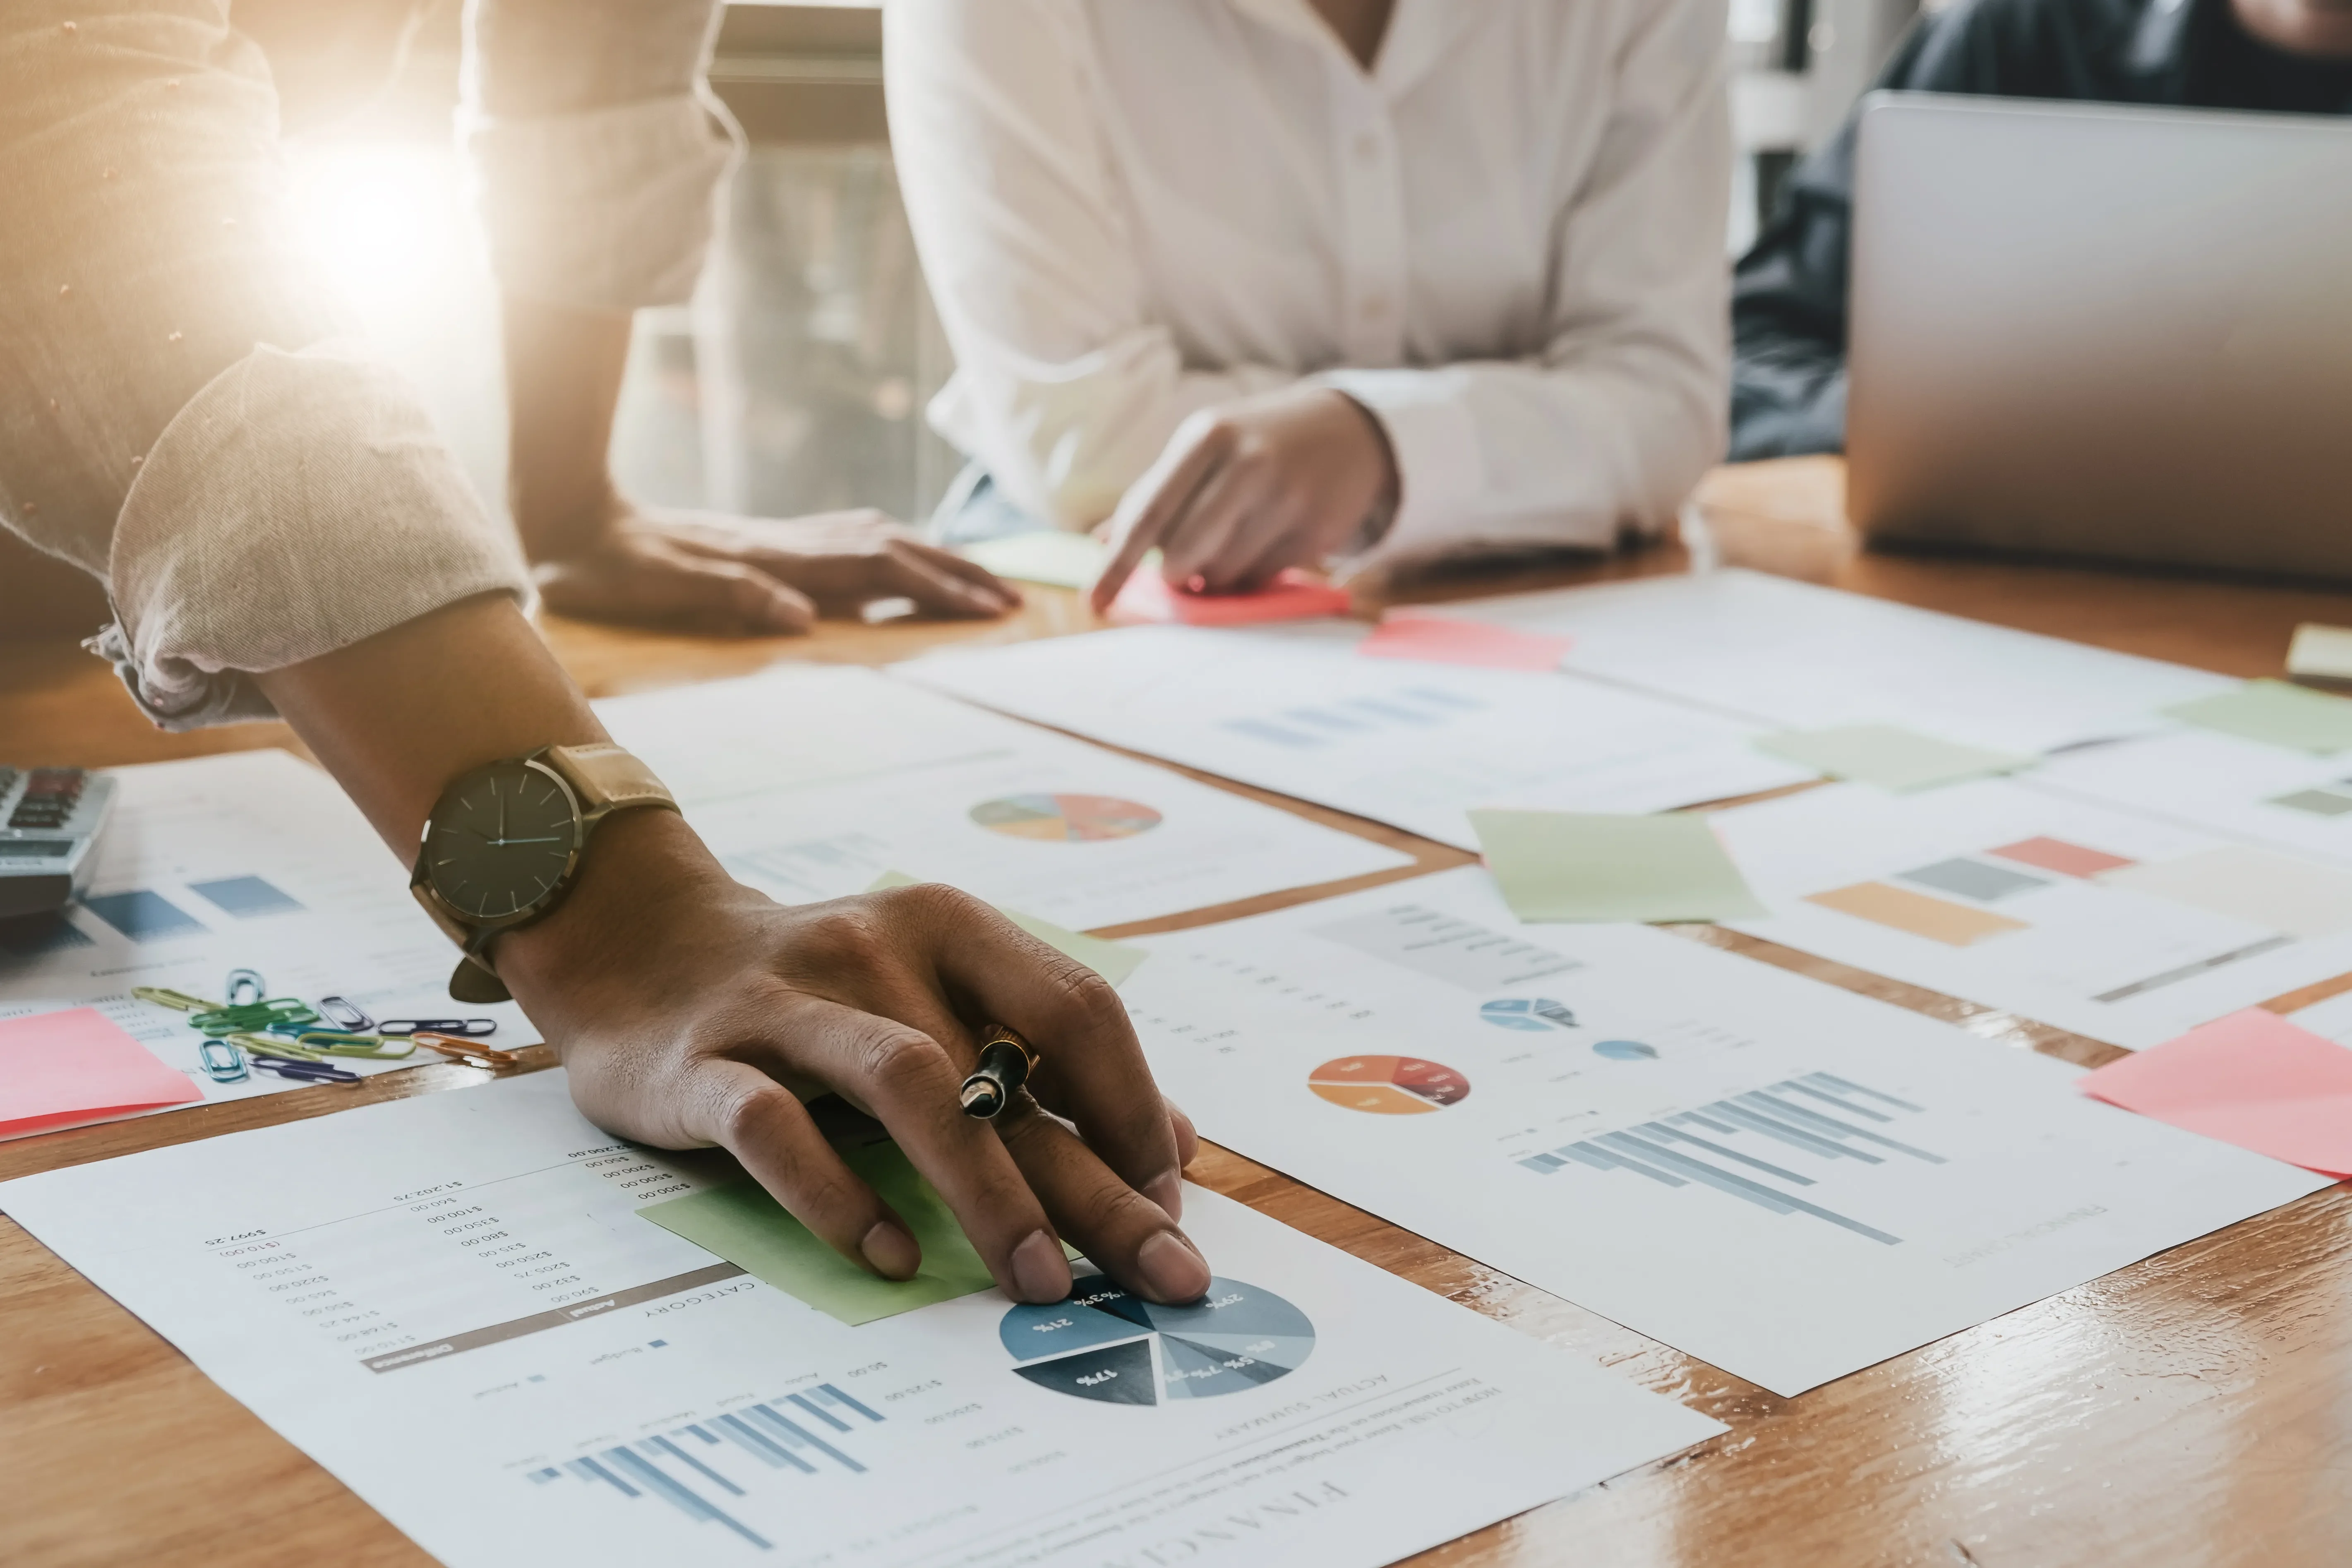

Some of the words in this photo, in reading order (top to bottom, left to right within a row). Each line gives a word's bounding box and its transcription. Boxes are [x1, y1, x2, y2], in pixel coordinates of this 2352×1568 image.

[568, 1145, 632, 1158] $2,200.00
[586, 1157, 629, 1168] $50.00
[603, 1164, 655, 1179] $200.00
[621, 1173, 673, 1189] $500.00
[394, 1181, 462, 1201] $1,202.75
[638, 1183, 691, 1200] $300.00
[410, 1197, 457, 1212] $60.00
[427, 1206, 482, 1223] $100.00
[444, 1217, 499, 1235] $350.00
[205, 1229, 266, 1246] $997.25
[461, 1231, 508, 1246] $80.00
[220, 1241, 280, 1257] ($10.00)
[479, 1242, 526, 1258] $35.00
[237, 1252, 296, 1269] $100.00
[496, 1251, 552, 1268] $250.00
[253, 1264, 312, 1280] $150.00
[514, 1262, 570, 1278] $205.75
[269, 1275, 329, 1292] $220.00
[532, 1275, 581, 1290] $32.00
[286, 1289, 336, 1304] $65.00
[551, 1287, 600, 1303] $90.00
[645, 1282, 755, 1318] CATEGORY
[319, 1310, 379, 1328] $144.25
[1033, 1318, 1073, 1333] 21%
[848, 1362, 887, 1378] $0.00
[1224, 1357, 1255, 1369] 5%
[1077, 1369, 1117, 1386] 17%
[1191, 1366, 1223, 1379] 7%
[885, 1380, 943, 1402] $125.00
[1313, 1374, 1388, 1403] ACTUAL
[924, 1403, 982, 1425] $250.00
[1215, 1402, 1312, 1441] SUMMARY
